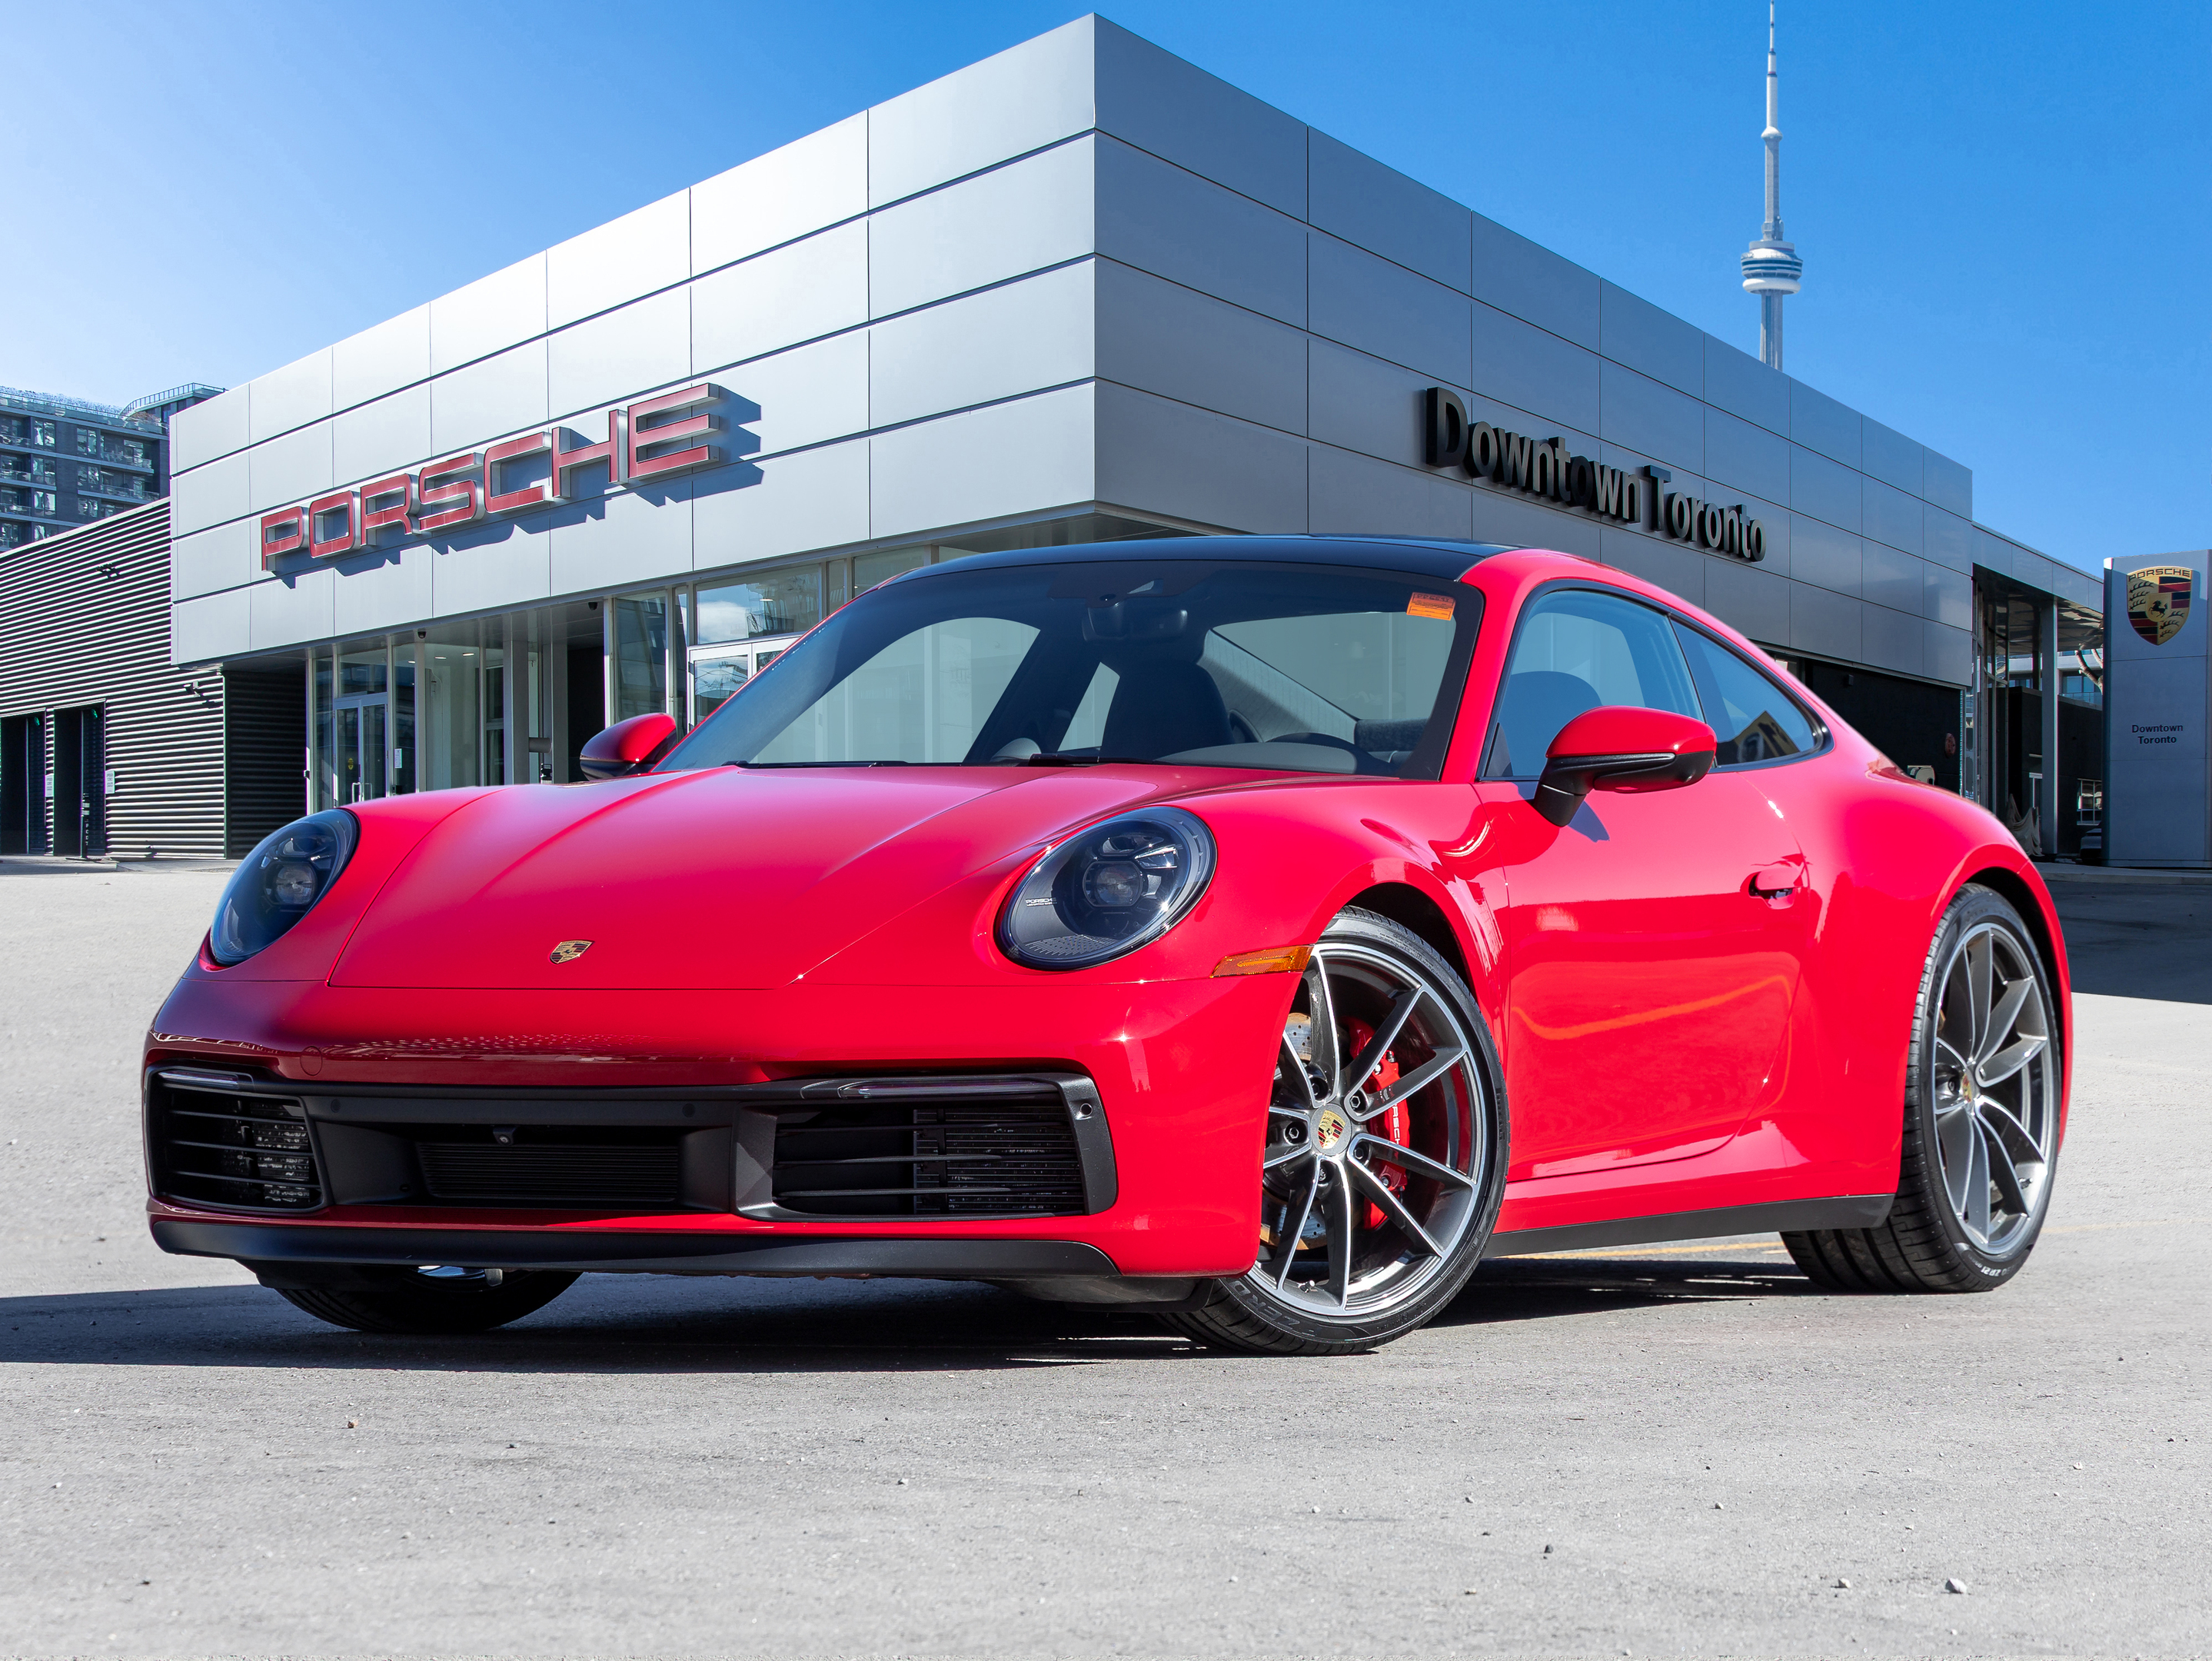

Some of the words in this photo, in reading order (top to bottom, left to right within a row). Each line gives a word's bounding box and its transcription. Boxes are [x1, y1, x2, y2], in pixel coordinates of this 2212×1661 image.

[261, 382, 720, 571] PORSCHE
[1425, 386, 1641, 524] Downtown
[1642, 464, 1767, 562] Toronto
[2128, 568, 2190, 582] PORSCHE
[2131, 724, 2184, 733] Downtown
[2137, 735, 2177, 744] Toronto
[1229, 1280, 1300, 1330] ZERO
